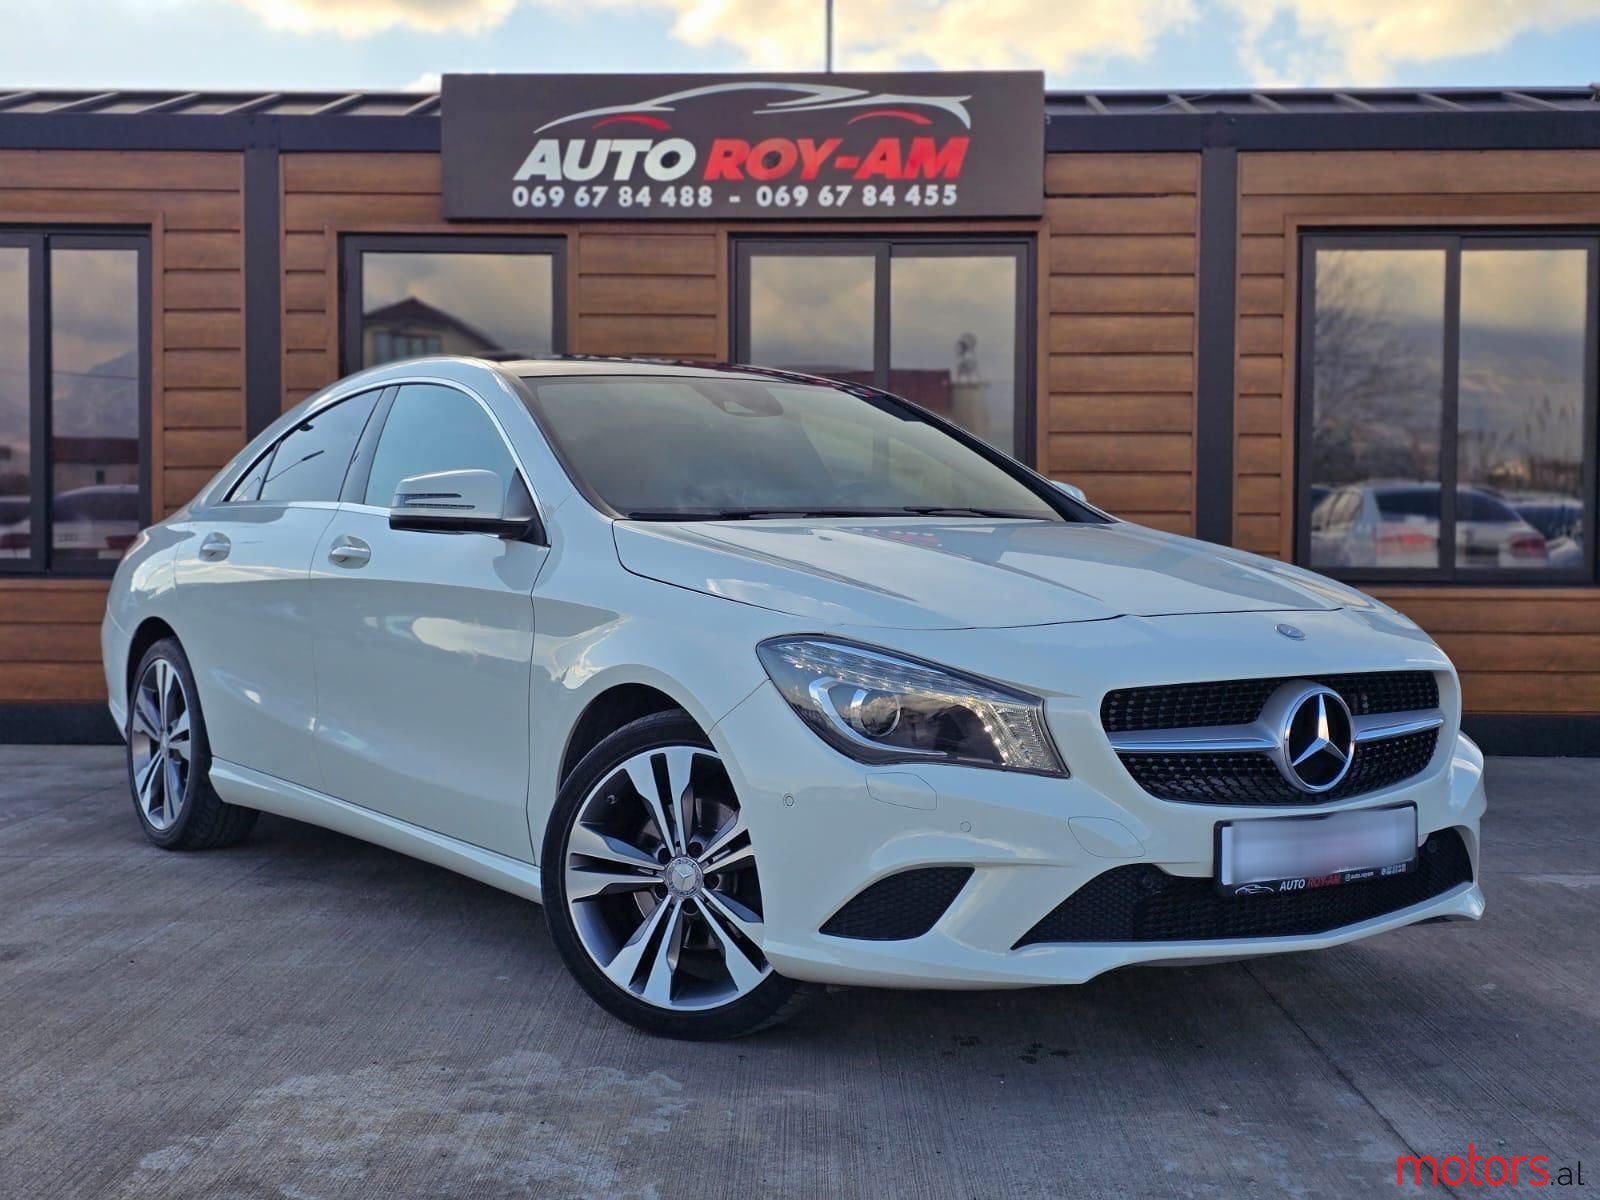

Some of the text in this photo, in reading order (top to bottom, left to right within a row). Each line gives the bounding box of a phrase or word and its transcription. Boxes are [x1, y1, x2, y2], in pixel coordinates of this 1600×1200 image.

[513, 135, 970, 182] AUTO ROY-AM
[512, 186, 565, 208] 069
[574, 186, 609, 208] 67
[618, 186, 652, 208] 84
[660, 186, 713, 208] 488
[755, 185, 809, 208] 069
[817, 185, 853, 207] 67
[861, 185, 896, 207] 84
[904, 184, 958, 207] 455
[1279, 878, 1306, 892] AUTO
